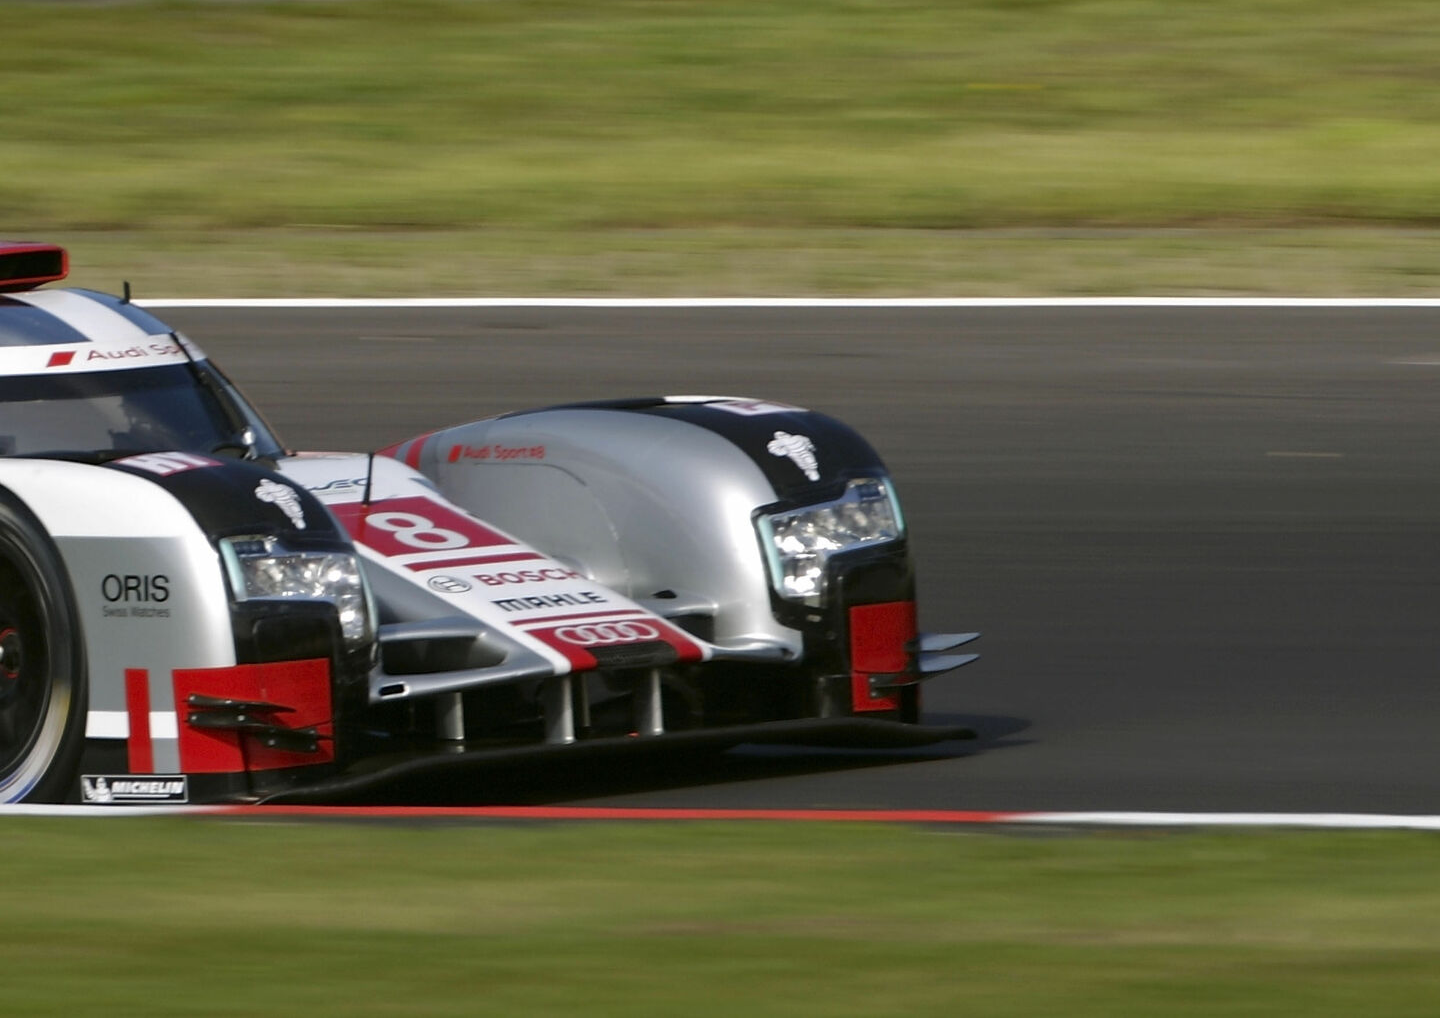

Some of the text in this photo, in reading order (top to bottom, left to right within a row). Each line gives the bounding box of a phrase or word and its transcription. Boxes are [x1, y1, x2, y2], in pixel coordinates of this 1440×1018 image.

[87, 346, 149, 361] Audi
[364, 512, 471, 550] 8
[472, 568, 589, 586] BOSCH
[101, 574, 170, 602] ORIS
[490, 591, 609, 612] MAHLE
[111, 781, 186, 795] MICHELIN
